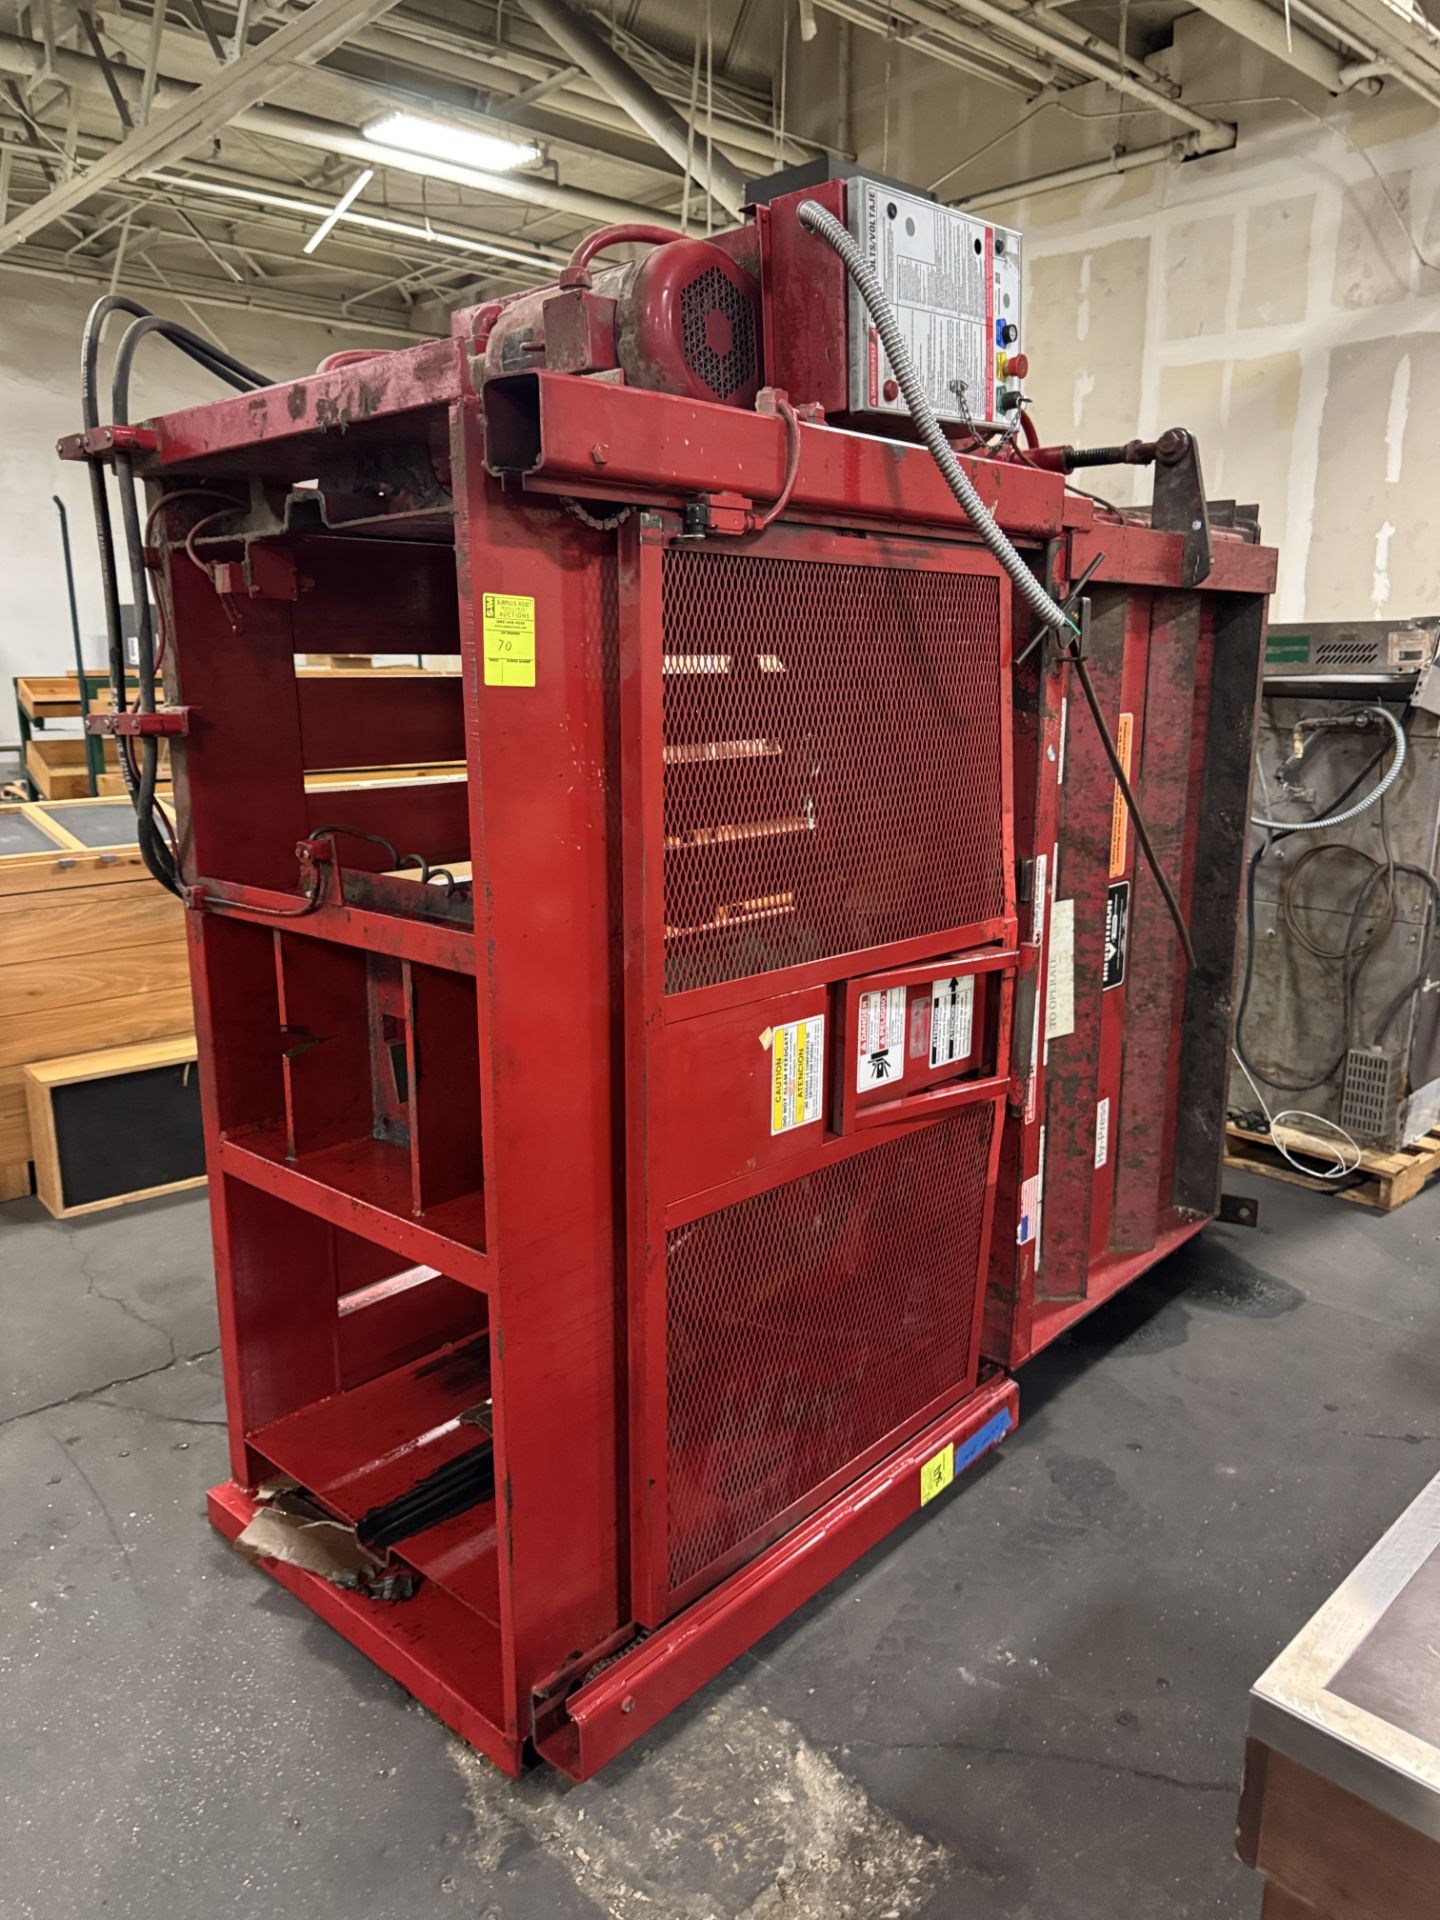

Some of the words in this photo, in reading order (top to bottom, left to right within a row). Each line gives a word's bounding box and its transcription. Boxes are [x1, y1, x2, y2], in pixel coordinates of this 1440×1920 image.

[498, 639, 512, 651] 70
[1049, 1012, 1057, 1030] TO
[1096, 1102, 1106, 1164] Hy-Press
